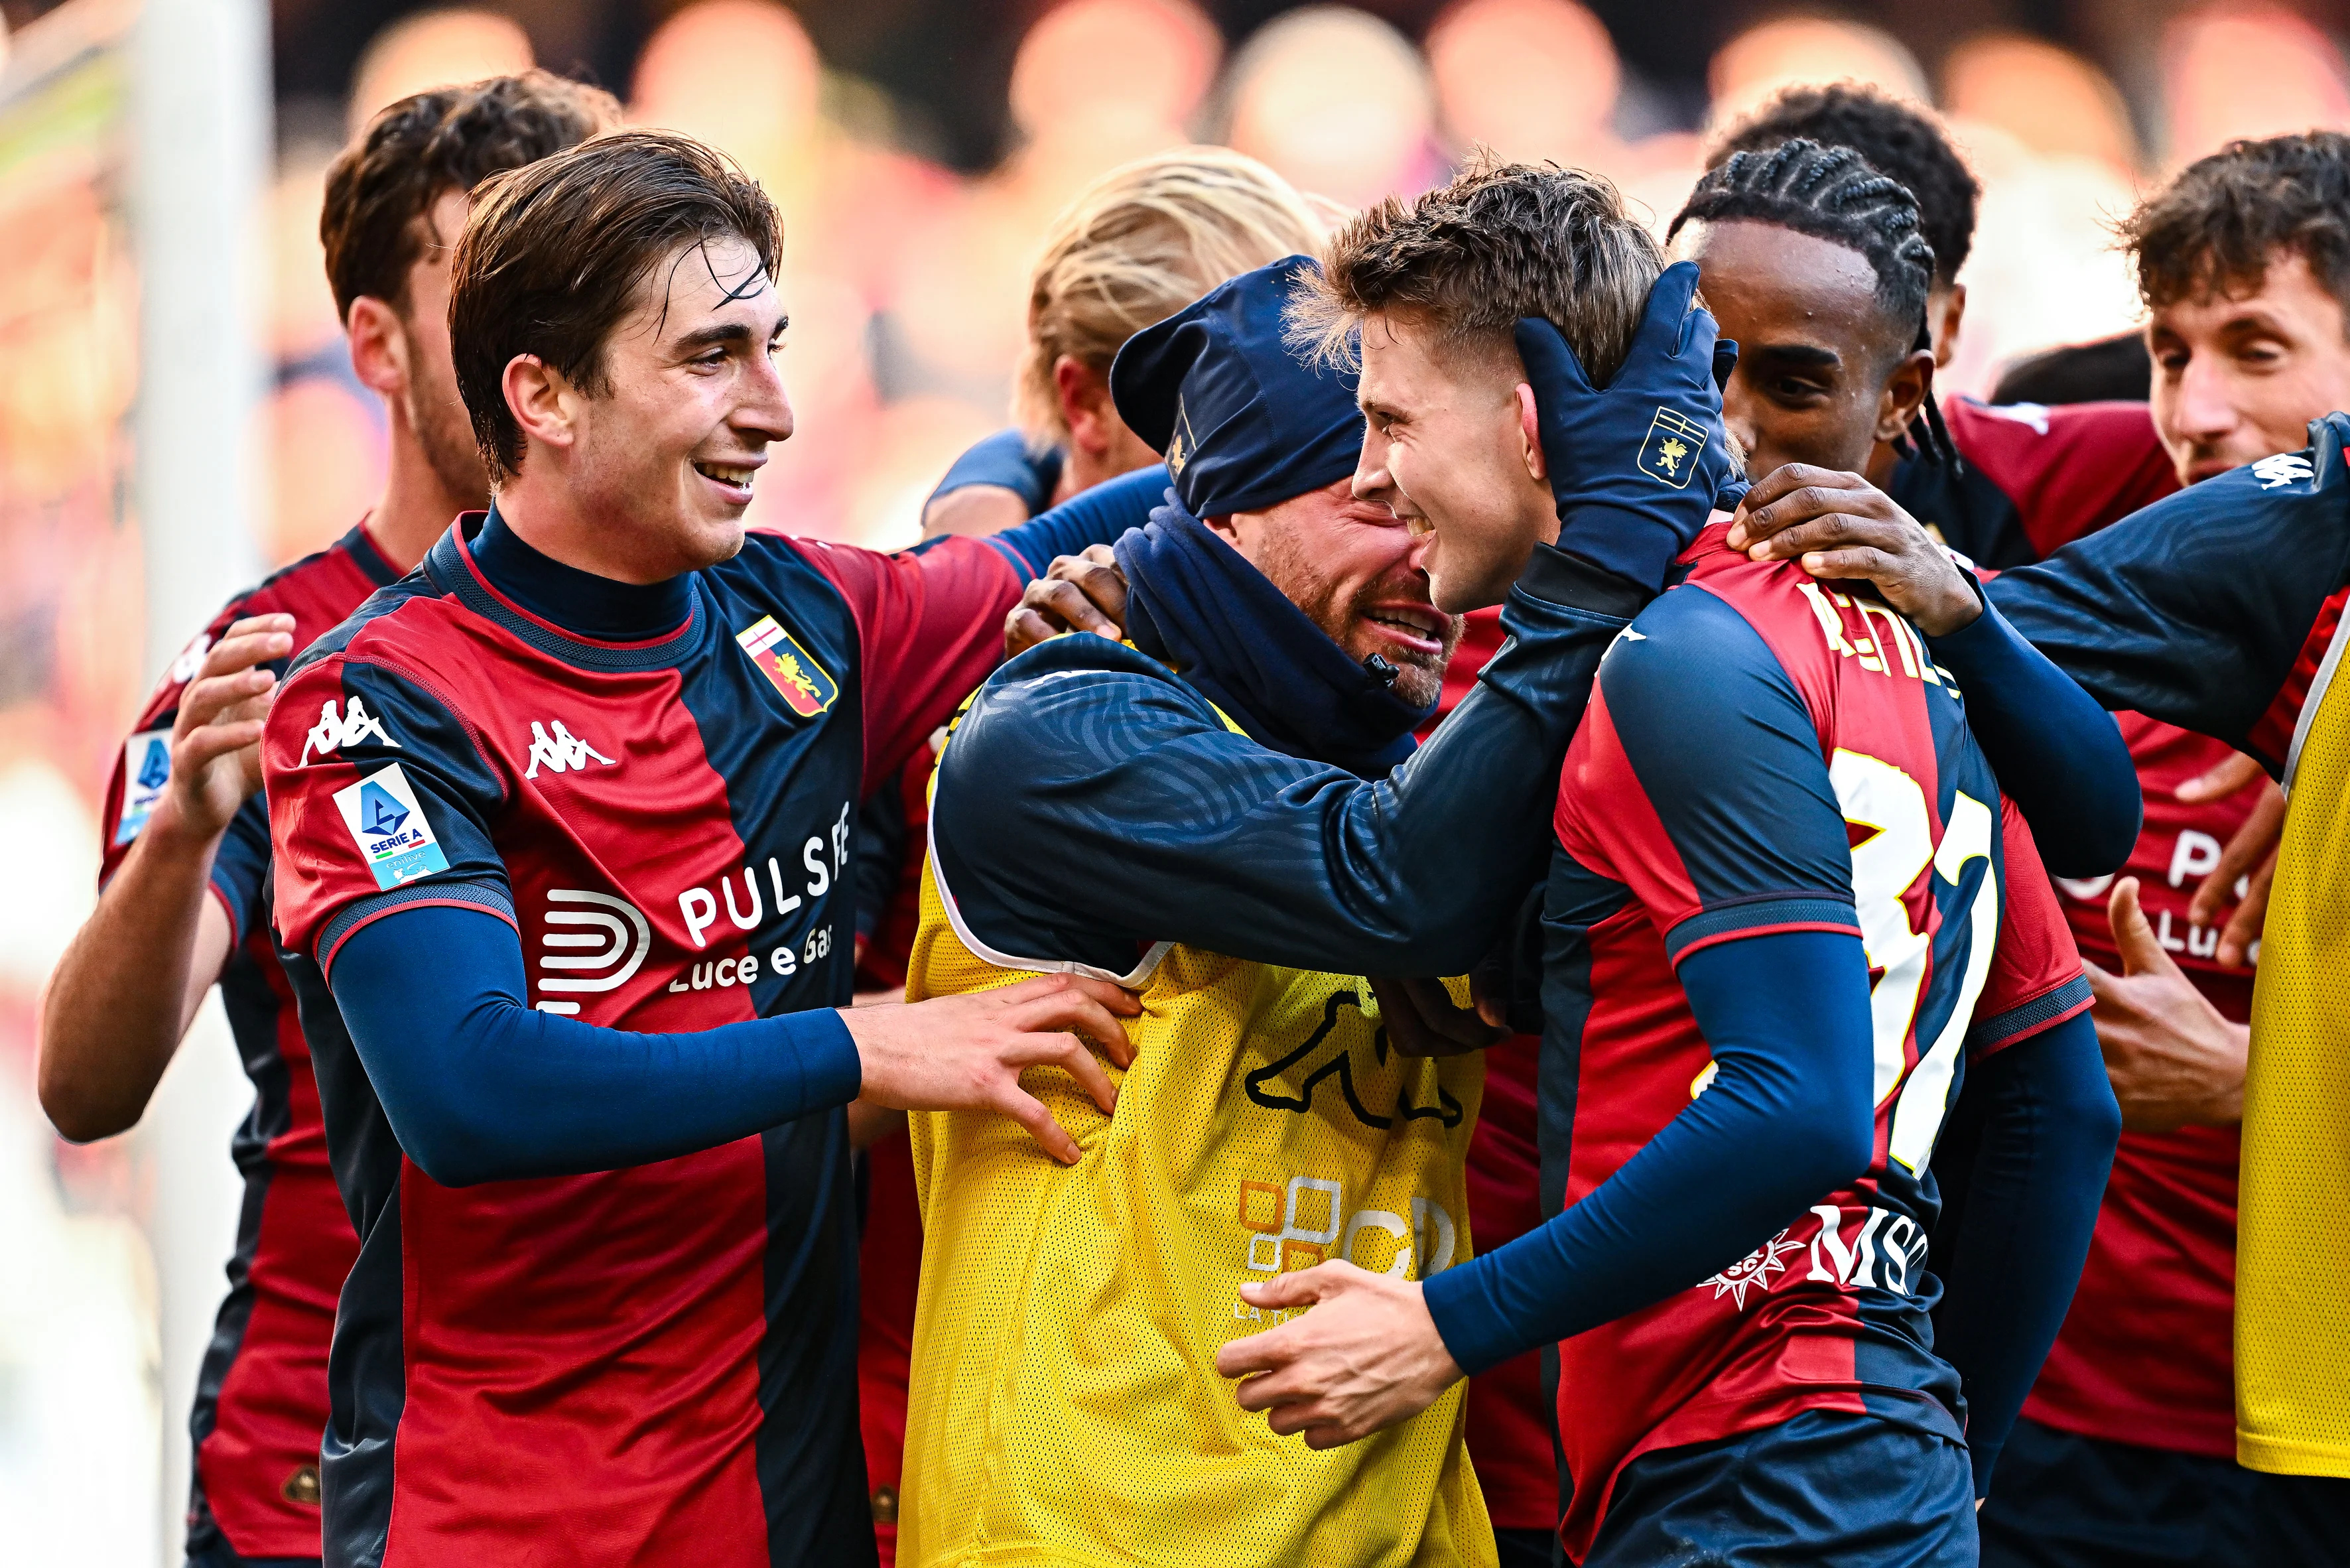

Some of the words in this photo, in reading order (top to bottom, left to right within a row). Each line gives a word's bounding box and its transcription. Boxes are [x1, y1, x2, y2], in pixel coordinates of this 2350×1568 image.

[371, 832, 410, 854] SERIE
[413, 828, 423, 840] A
[386, 850, 426, 869] enilive
[669, 955, 759, 993] Luce
[771, 947, 797, 975] e
[1807, 1205, 1929, 1297] MS
